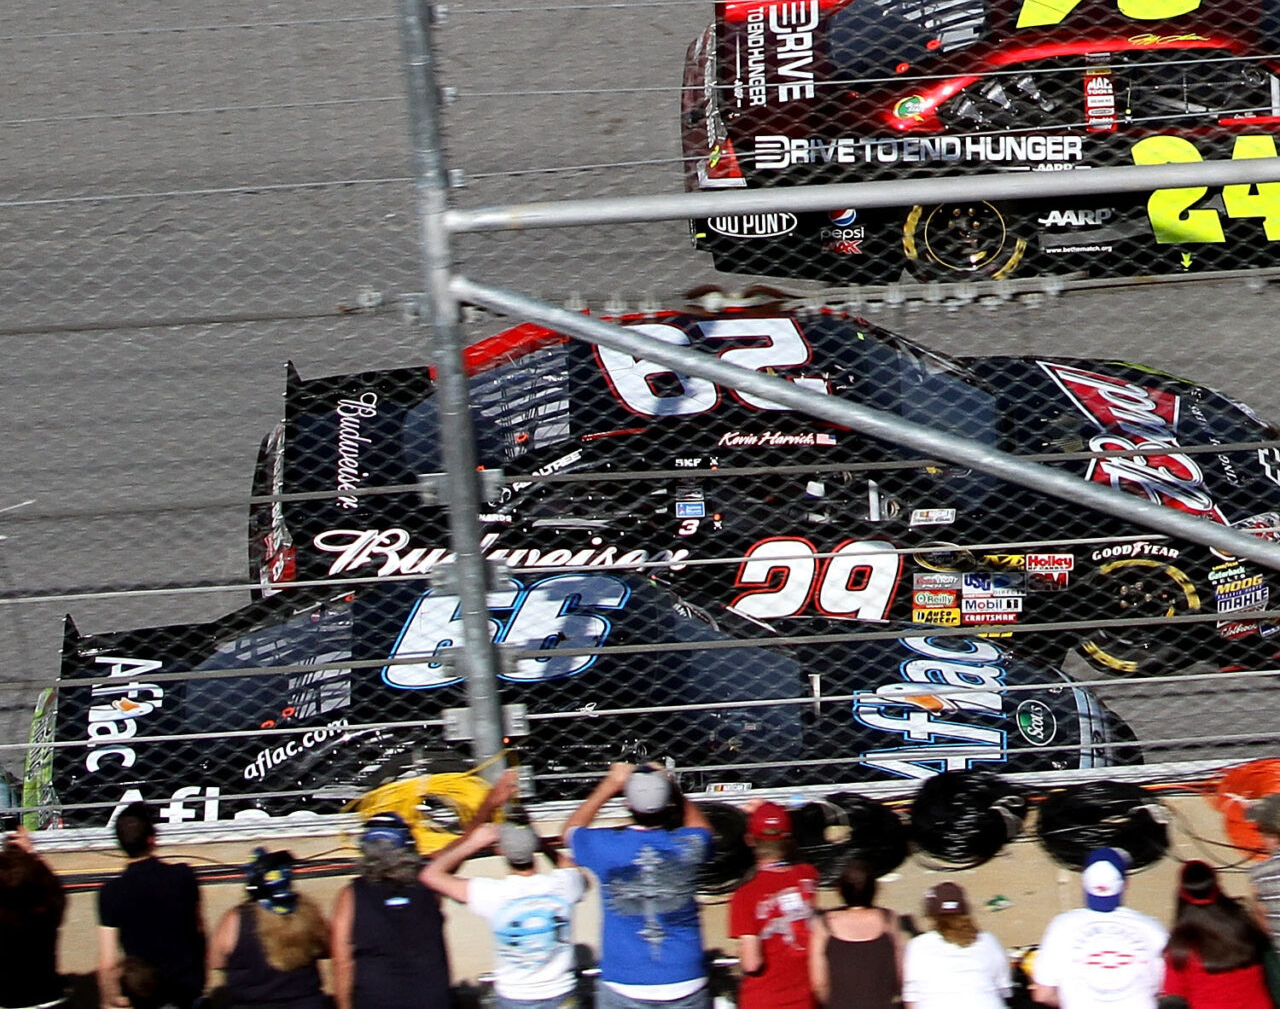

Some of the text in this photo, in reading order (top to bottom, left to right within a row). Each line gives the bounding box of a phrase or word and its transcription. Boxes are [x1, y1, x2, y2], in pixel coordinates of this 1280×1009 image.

[747, 47, 767, 107] HUNGER
[965, 135, 1083, 162] HUNGER
[1040, 208, 1112, 227] AARP
[820, 226, 865, 241] pepsi
[718, 431, 815, 446] Kevin Harvick
[675, 458, 702, 467] SKF
[478, 513, 513, 523] NARDS
[678, 519, 701, 536] 3
[1091, 541, 1180, 562] GOODYEAR
[1027, 554, 1073, 569] Holley
[727, 535, 905, 621] 29
[964, 574, 991, 591] USG
[1216, 573, 1264, 594] MOOG
[965, 598, 1003, 611] Mobil
[1219, 588, 1269, 612] MAHLE
[928, 610, 953, 618] Auto
[964, 613, 1017, 622] CRAFTSMAN
[86, 656, 165, 773] Aflac
[242, 716, 350, 780] aflac.com
[106, 785, 323, 827] Afl
